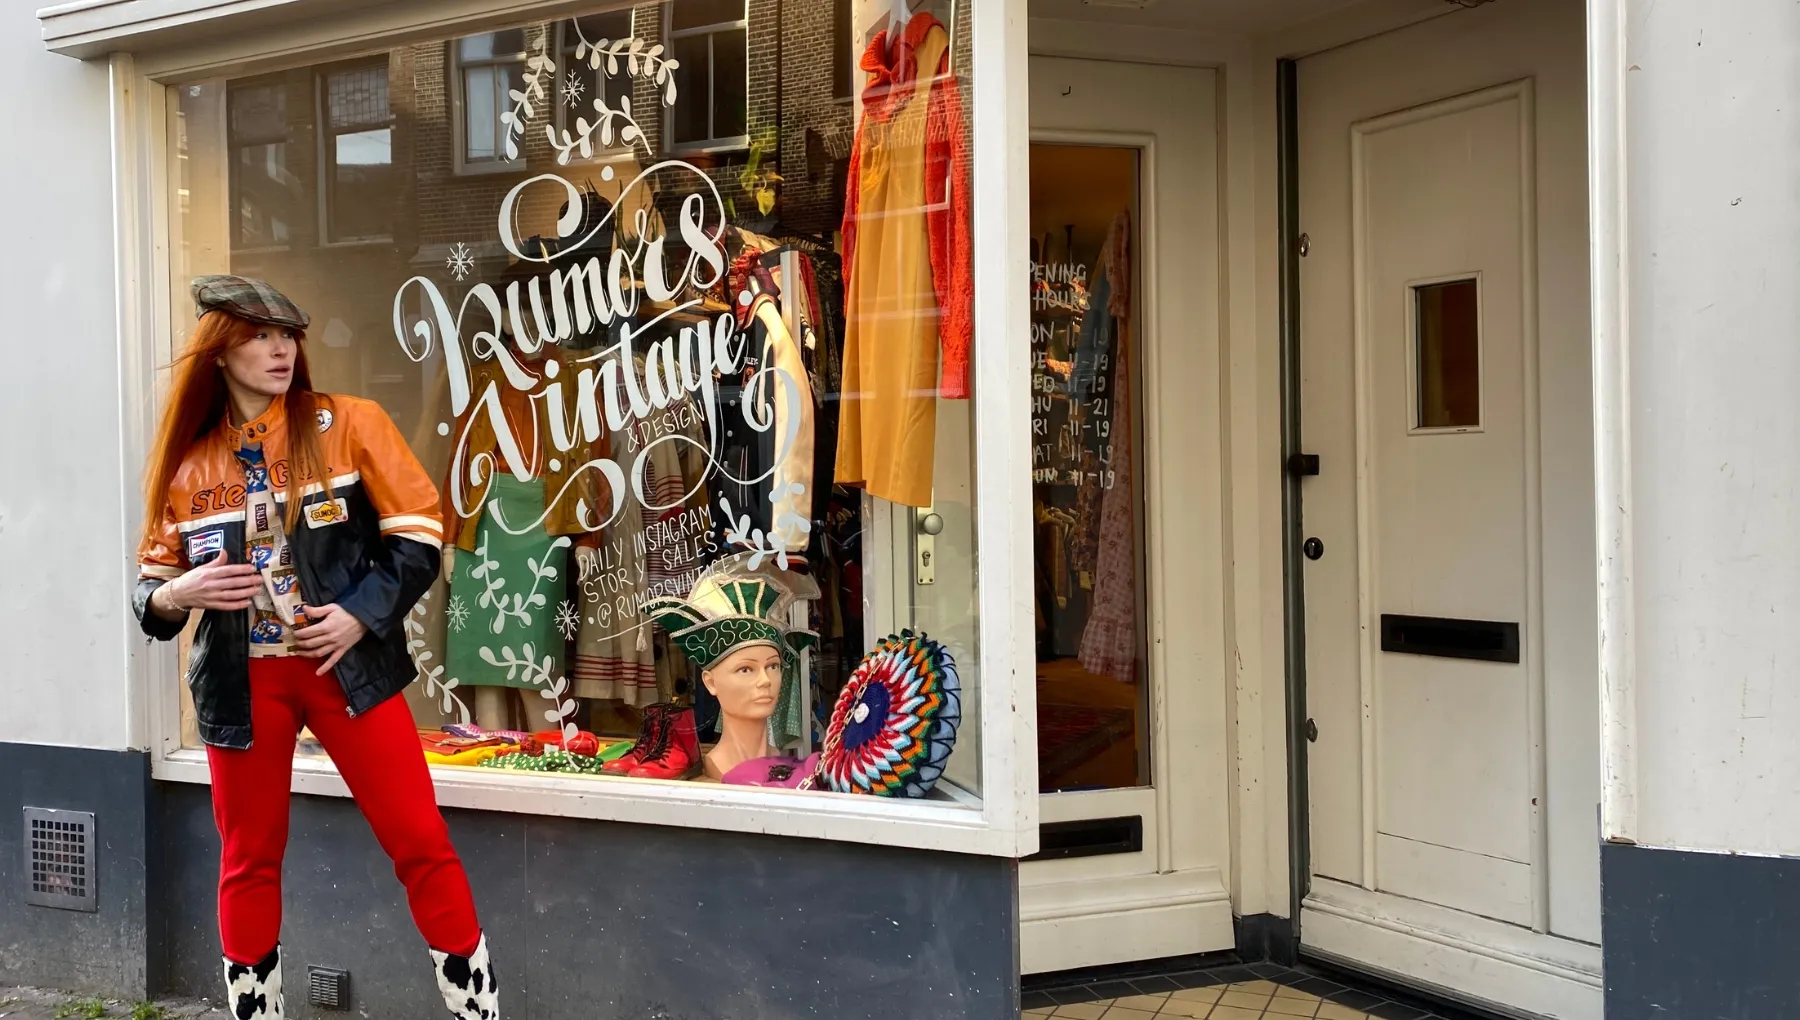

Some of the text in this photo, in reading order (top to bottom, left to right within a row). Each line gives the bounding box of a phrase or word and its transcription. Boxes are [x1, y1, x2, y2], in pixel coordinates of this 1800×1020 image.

[1030, 260, 1087, 284] PENING
[393, 162, 730, 417] Rumors
[1032, 288, 1092, 313] HOURS
[1032, 373, 1055, 393] ED
[450, 299, 748, 520] Vintage
[1031, 396, 1052, 414] HU
[624, 399, 705, 453] & DESIGN
[1032, 418, 1049, 436] RI
[1033, 443, 1053, 464] AT
[1032, 467, 1057, 484] UN
[314, 507, 338, 519] SUNOC
[193, 537, 220, 549] CHAMPION
[577, 504, 715, 581] DAILY INSTAGRAM
[662, 531, 717, 571] SALES
